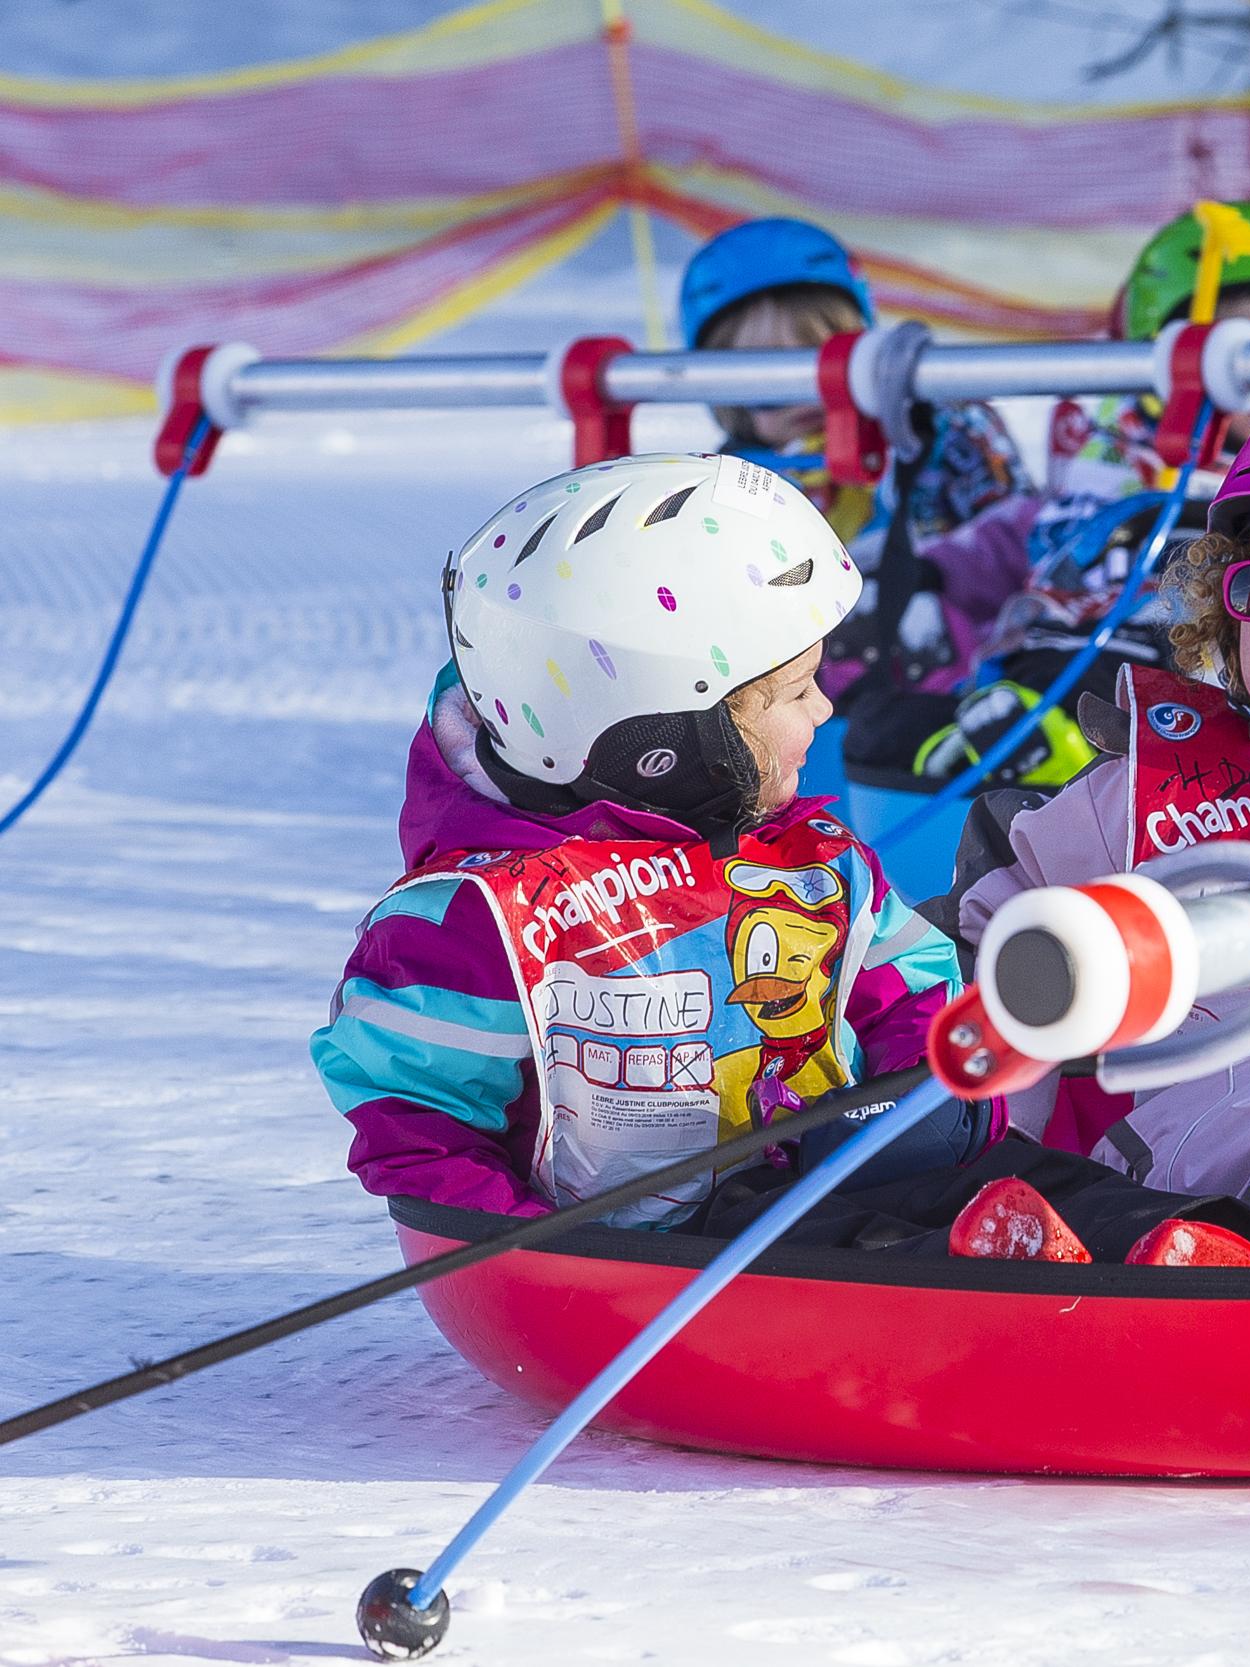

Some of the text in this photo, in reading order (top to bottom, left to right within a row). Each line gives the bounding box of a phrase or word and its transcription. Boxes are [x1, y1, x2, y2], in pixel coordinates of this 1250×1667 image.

[545, 979, 705, 1031] JUSTINE
[588, 1047, 613, 1064] MAT.
[628, 1053, 664, 1065] REPAS
[591, 1094, 616, 1105] LEBRE
[615, 1099, 646, 1108] JUSTINE
[843, 1100, 897, 1121] wed'z
